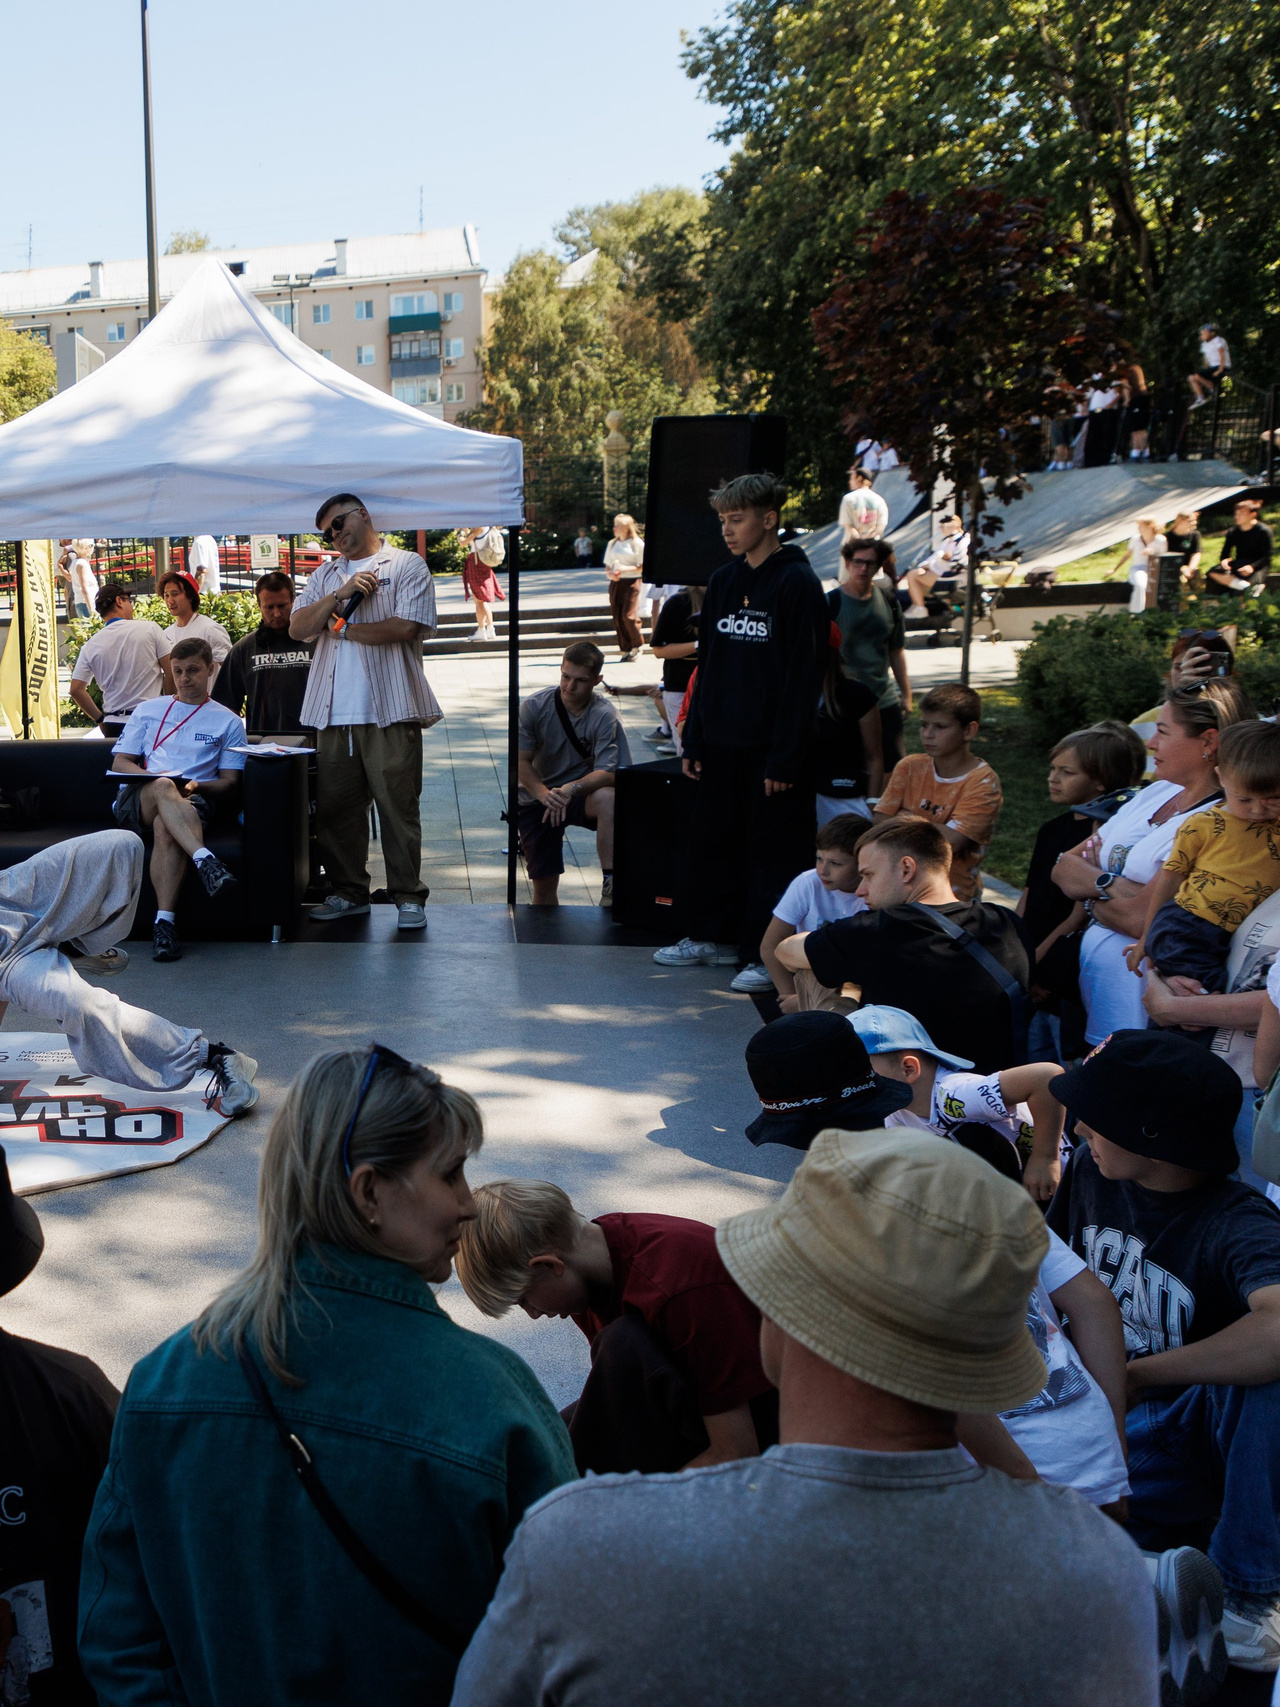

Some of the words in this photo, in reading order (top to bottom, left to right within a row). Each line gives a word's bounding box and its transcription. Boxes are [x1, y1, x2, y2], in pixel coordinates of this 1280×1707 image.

[716, 614, 768, 637] didas
[841, 1080, 877, 1098] Break
[57, 1113, 163, 1139] НО
